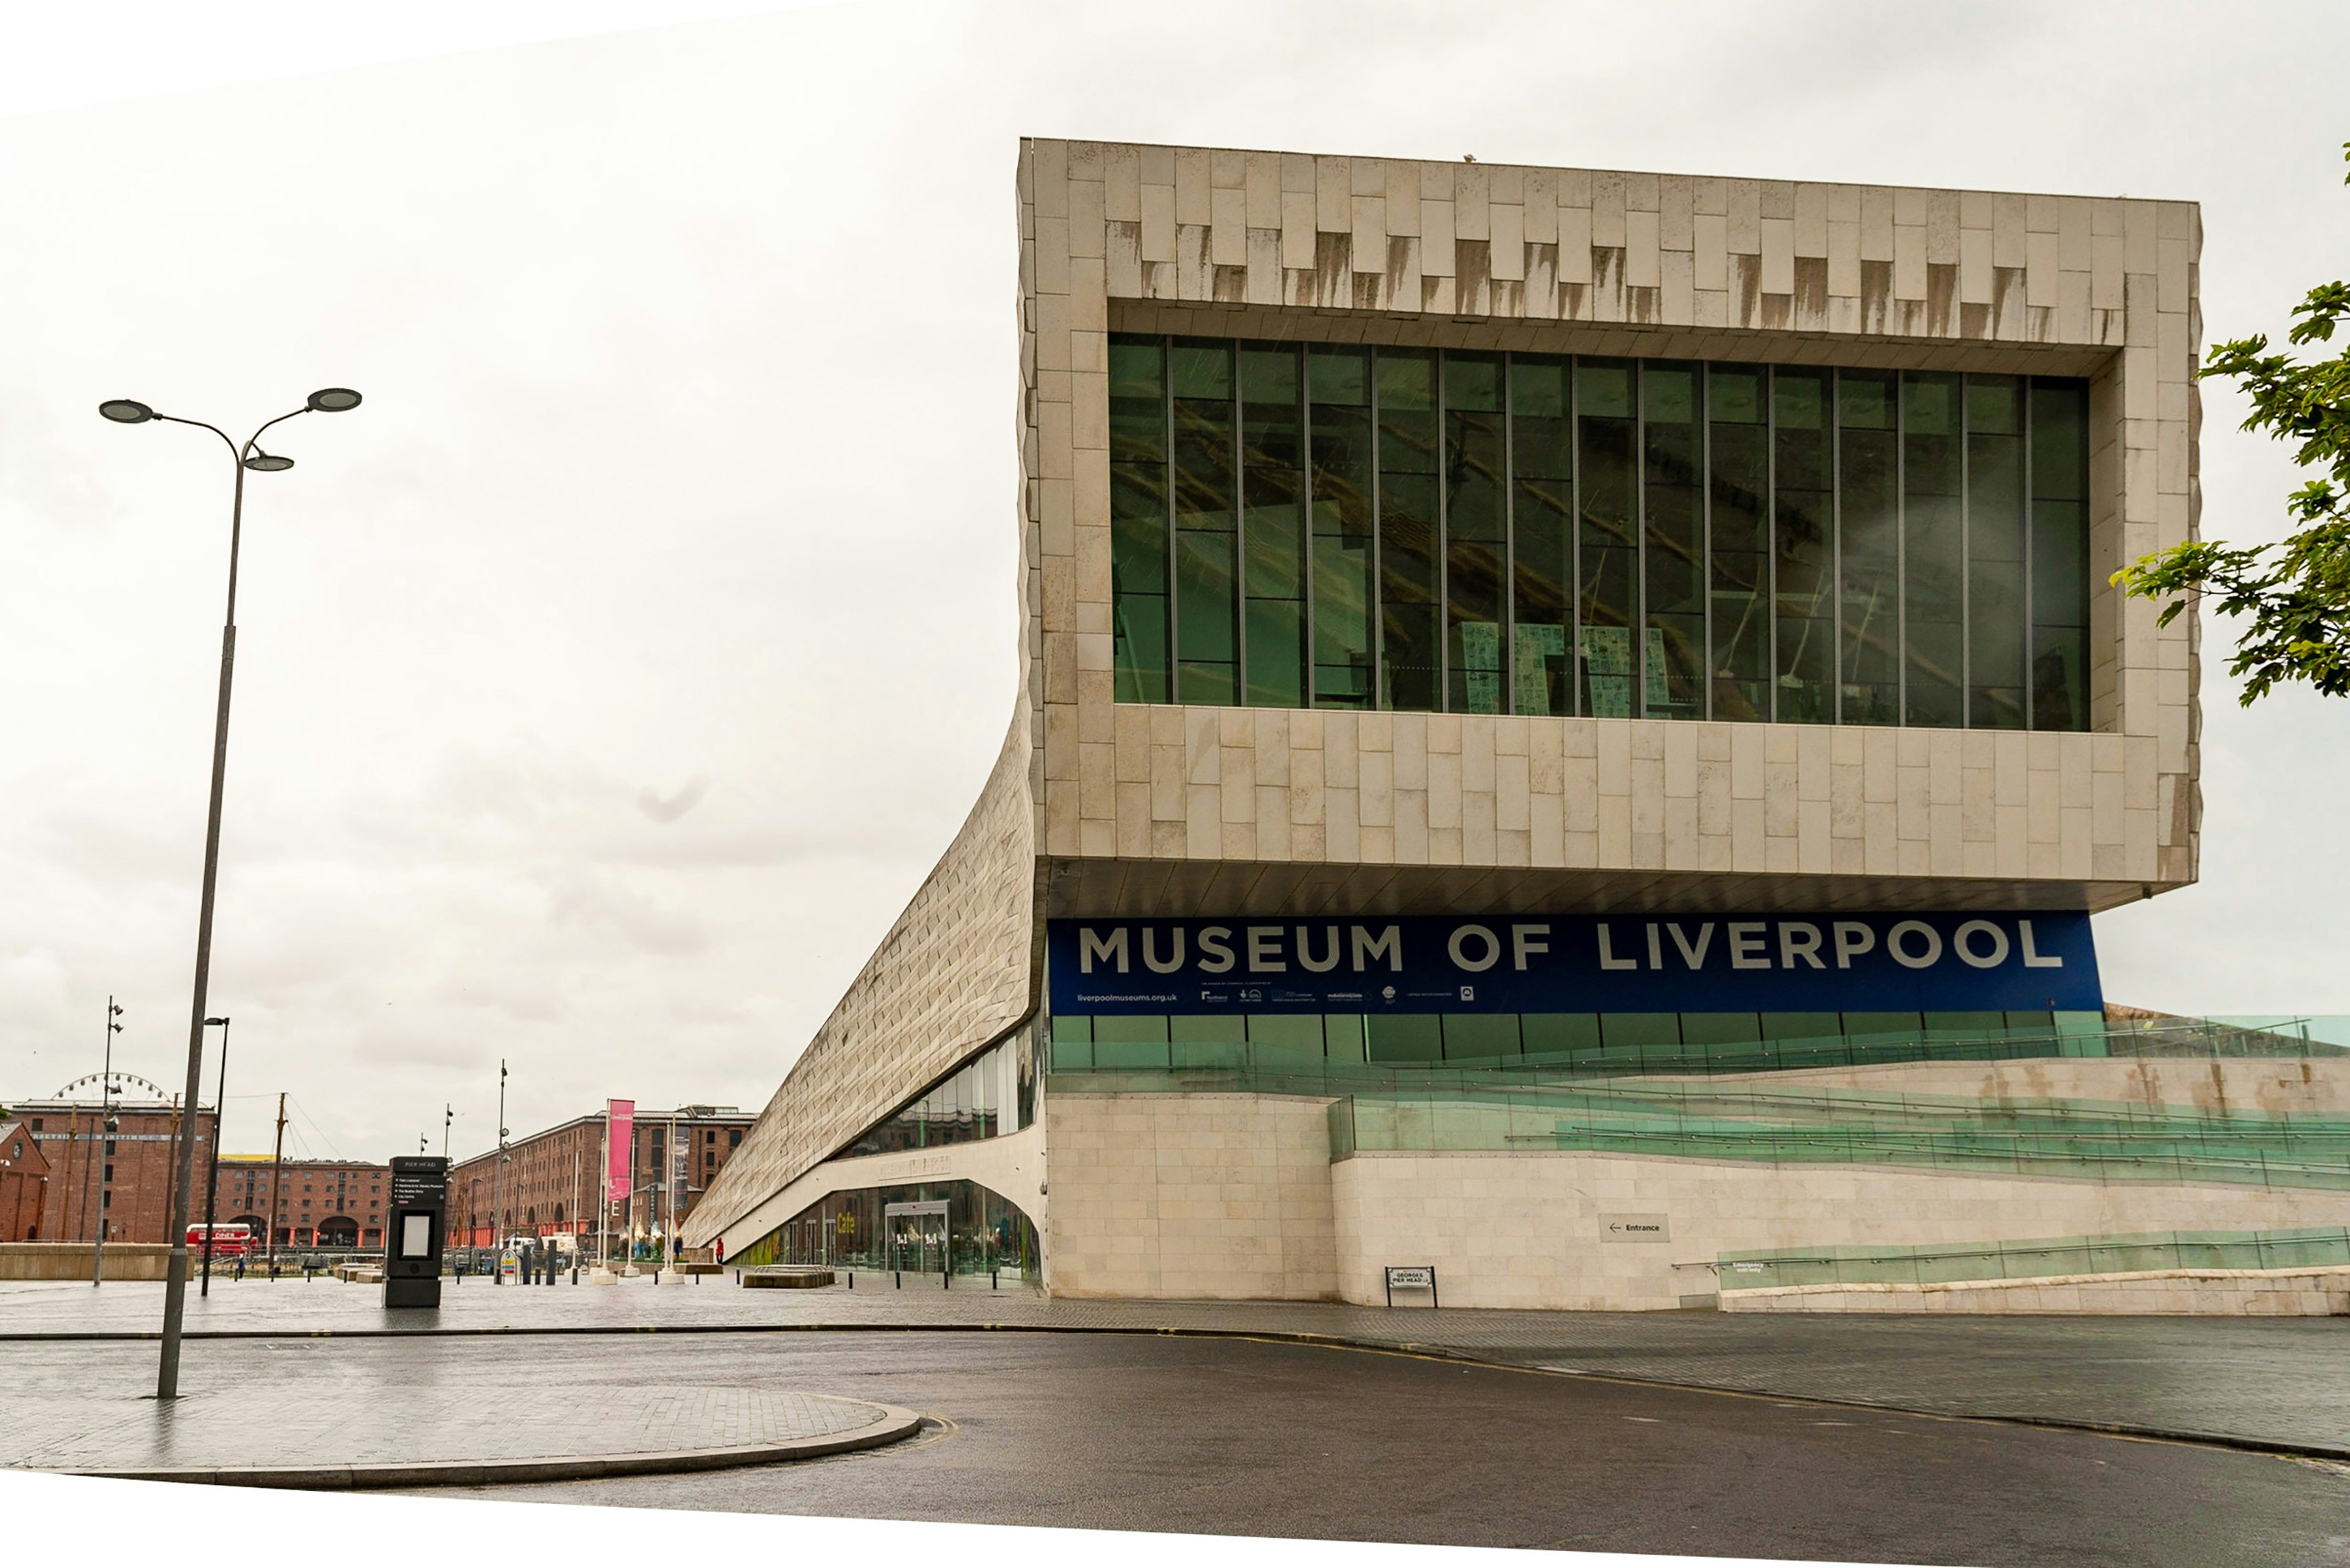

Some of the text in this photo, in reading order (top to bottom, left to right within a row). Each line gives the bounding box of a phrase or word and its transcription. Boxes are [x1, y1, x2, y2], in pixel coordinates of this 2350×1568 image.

[1079, 919, 2063, 973] MUSEUM OF LIVERPOOL
[1077, 993, 1177, 1002] liverpoolmuseums.org.uk
